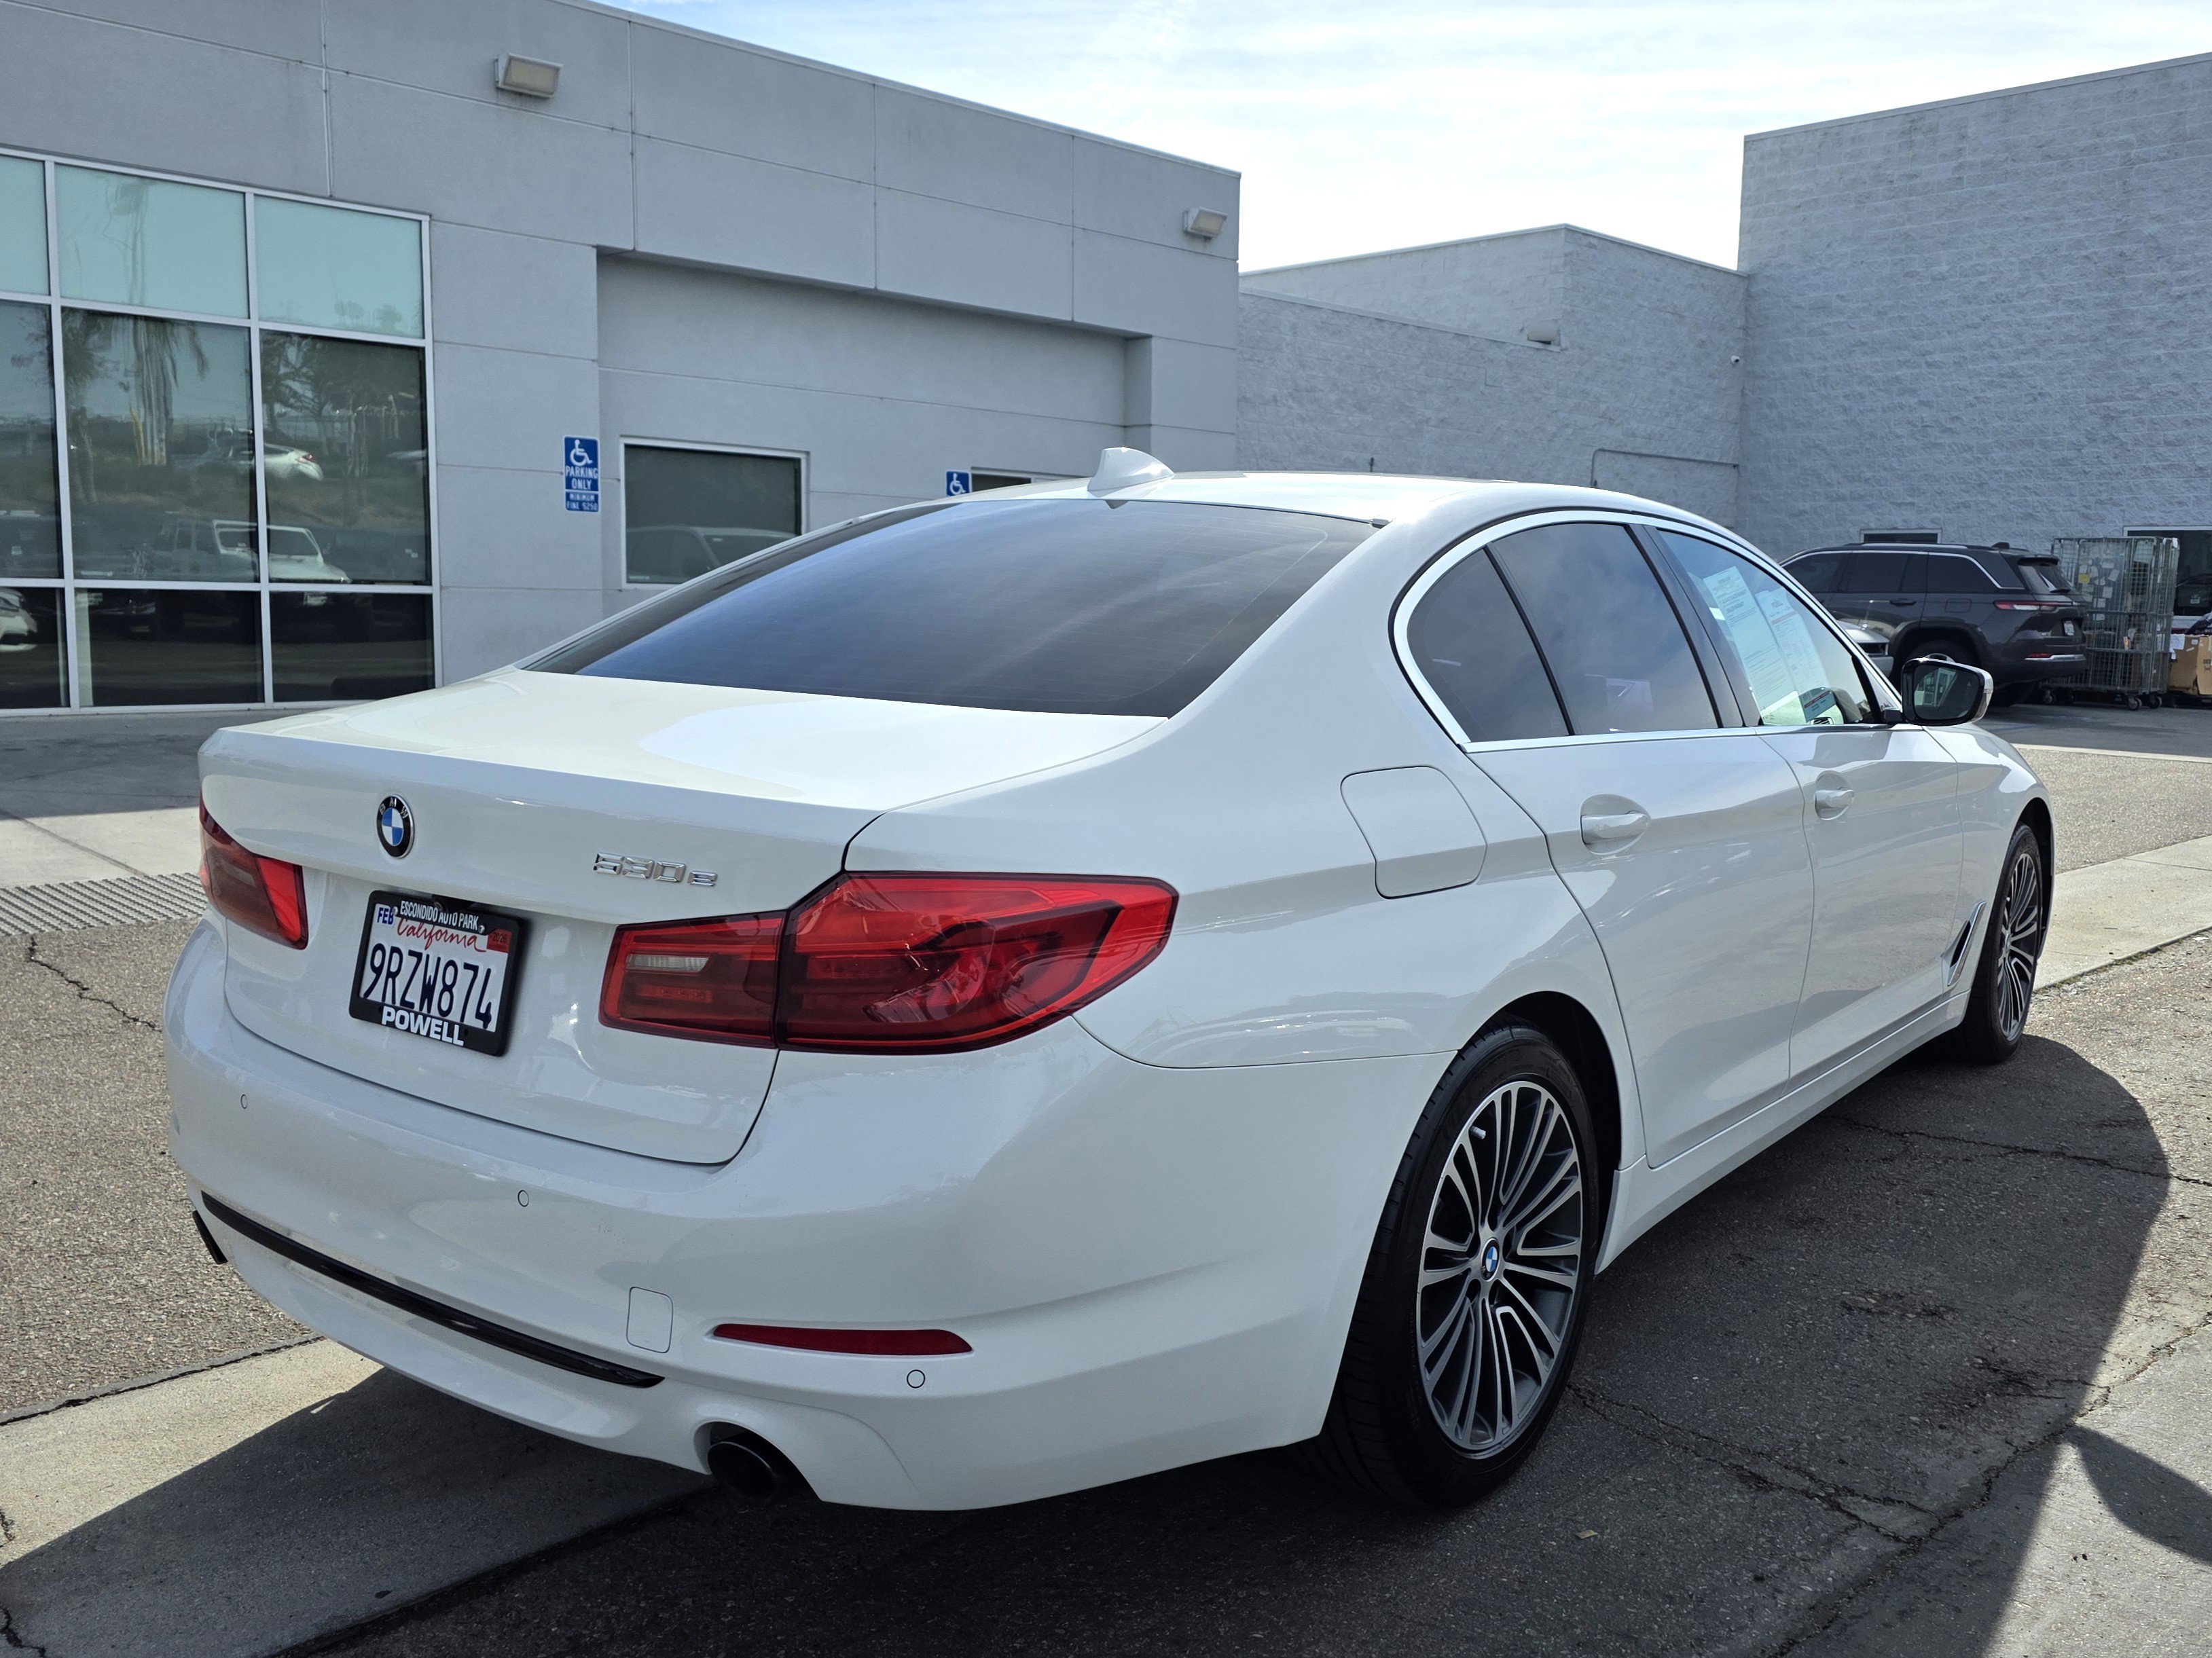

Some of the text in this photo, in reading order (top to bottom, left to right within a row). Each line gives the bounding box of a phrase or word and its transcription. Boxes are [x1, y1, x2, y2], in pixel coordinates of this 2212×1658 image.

[566, 466, 598, 479] PARKING
[571, 478, 592, 490] ONLY
[380, 796, 409, 819] BMW
[593, 852, 718, 887] 530e
[377, 907, 395, 925] FEB
[400, 900, 479, 930] ESCONDIDO AUTO PARK
[397, 917, 487, 952] California
[492, 932, 507, 944] 2026
[363, 943, 492, 1029] 9RZW874
[382, 1006, 464, 1046] POWELL
